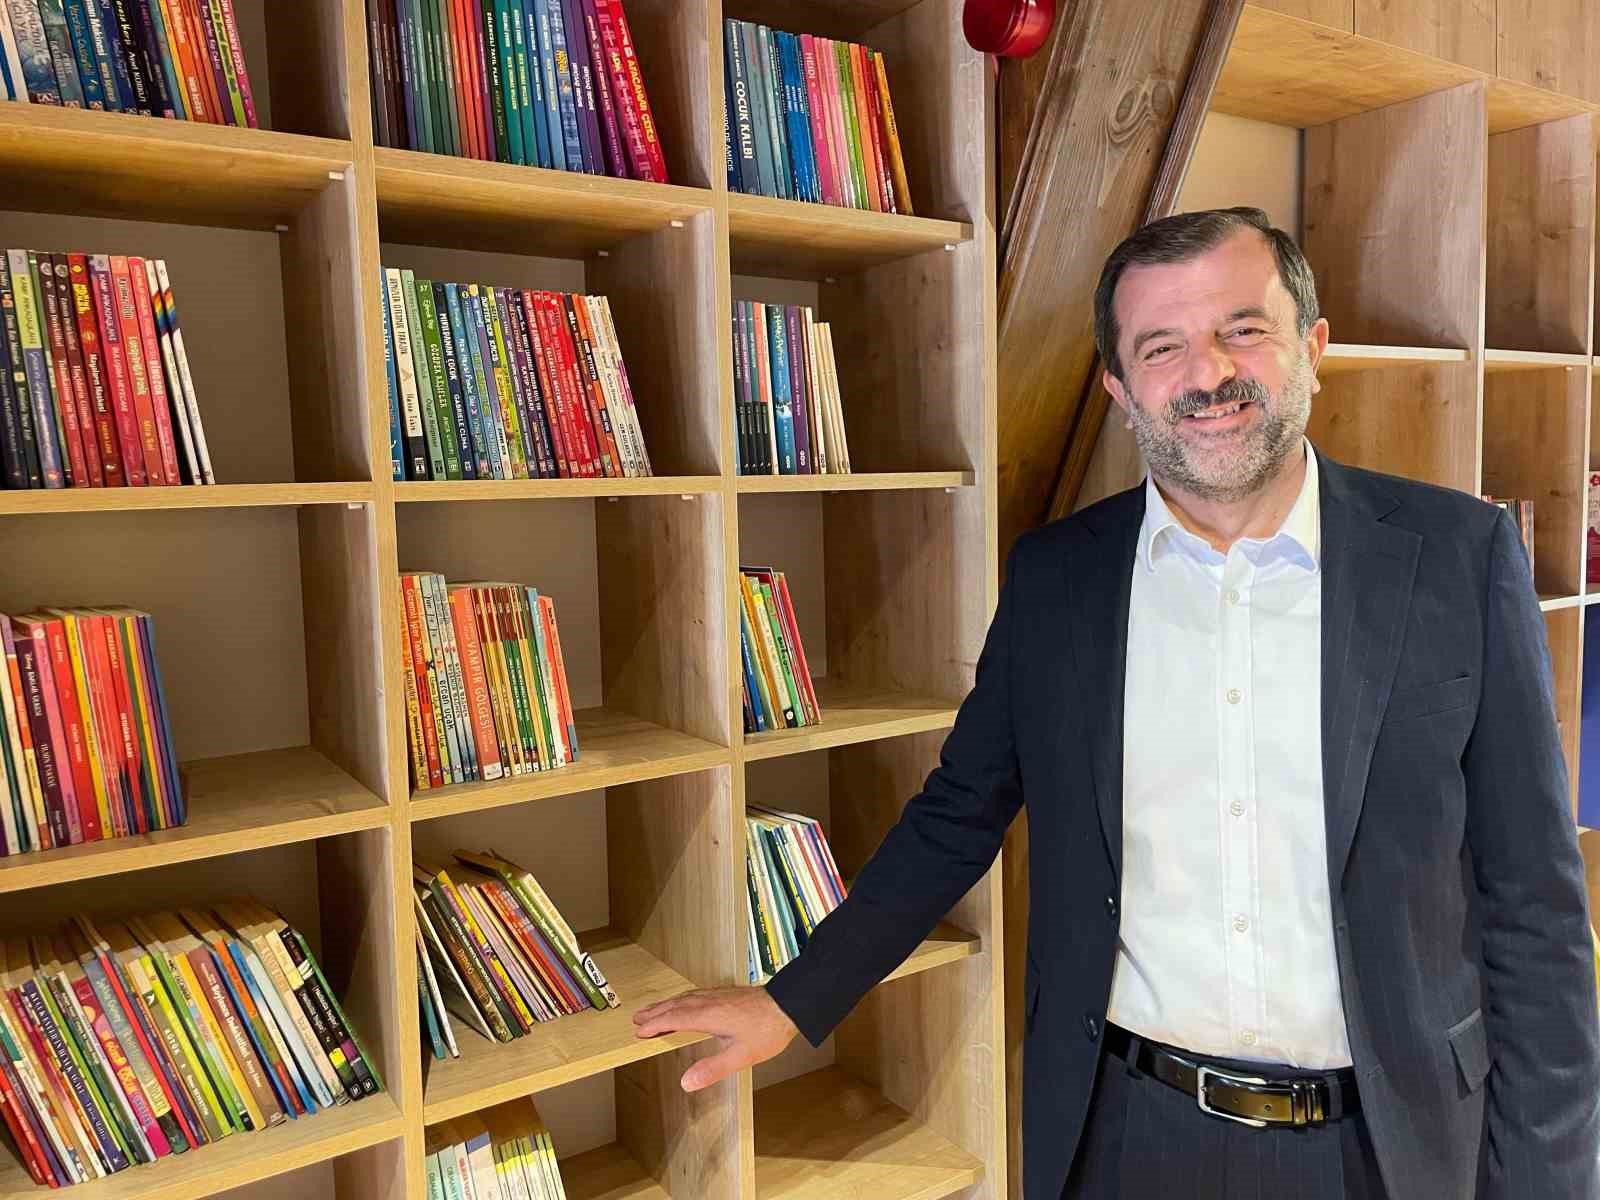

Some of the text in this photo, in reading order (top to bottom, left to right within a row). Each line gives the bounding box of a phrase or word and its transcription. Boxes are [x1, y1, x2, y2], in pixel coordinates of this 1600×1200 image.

[804, 52, 815, 78] HEIDI
[438, 679, 454, 730] ercan uçak
